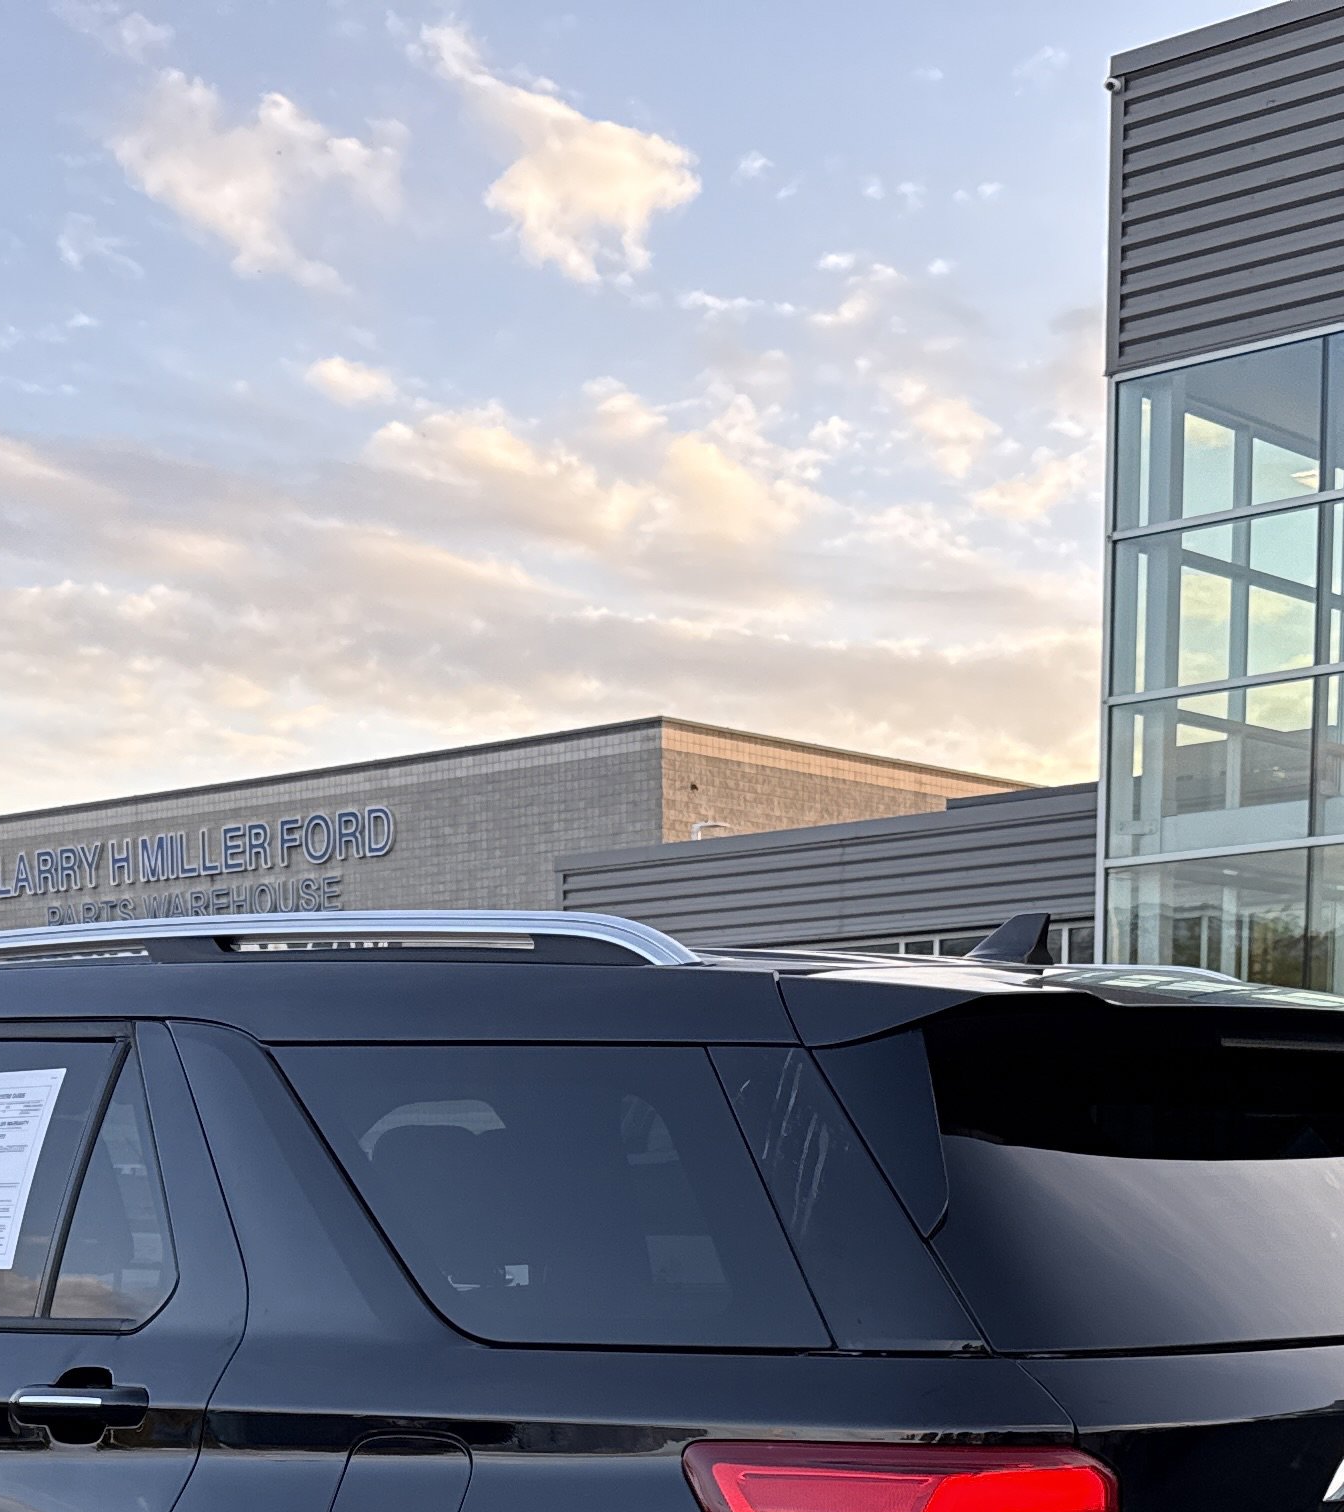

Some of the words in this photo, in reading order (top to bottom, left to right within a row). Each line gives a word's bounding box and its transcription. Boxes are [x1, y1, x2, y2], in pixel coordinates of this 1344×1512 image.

[109, 838, 133, 886] H
[139, 822, 271, 882] MILLER
[277, 805, 395, 867] FORD
[47, 897, 135, 926] PARTS
[142, 875, 342, 919] WAREHOUSE
